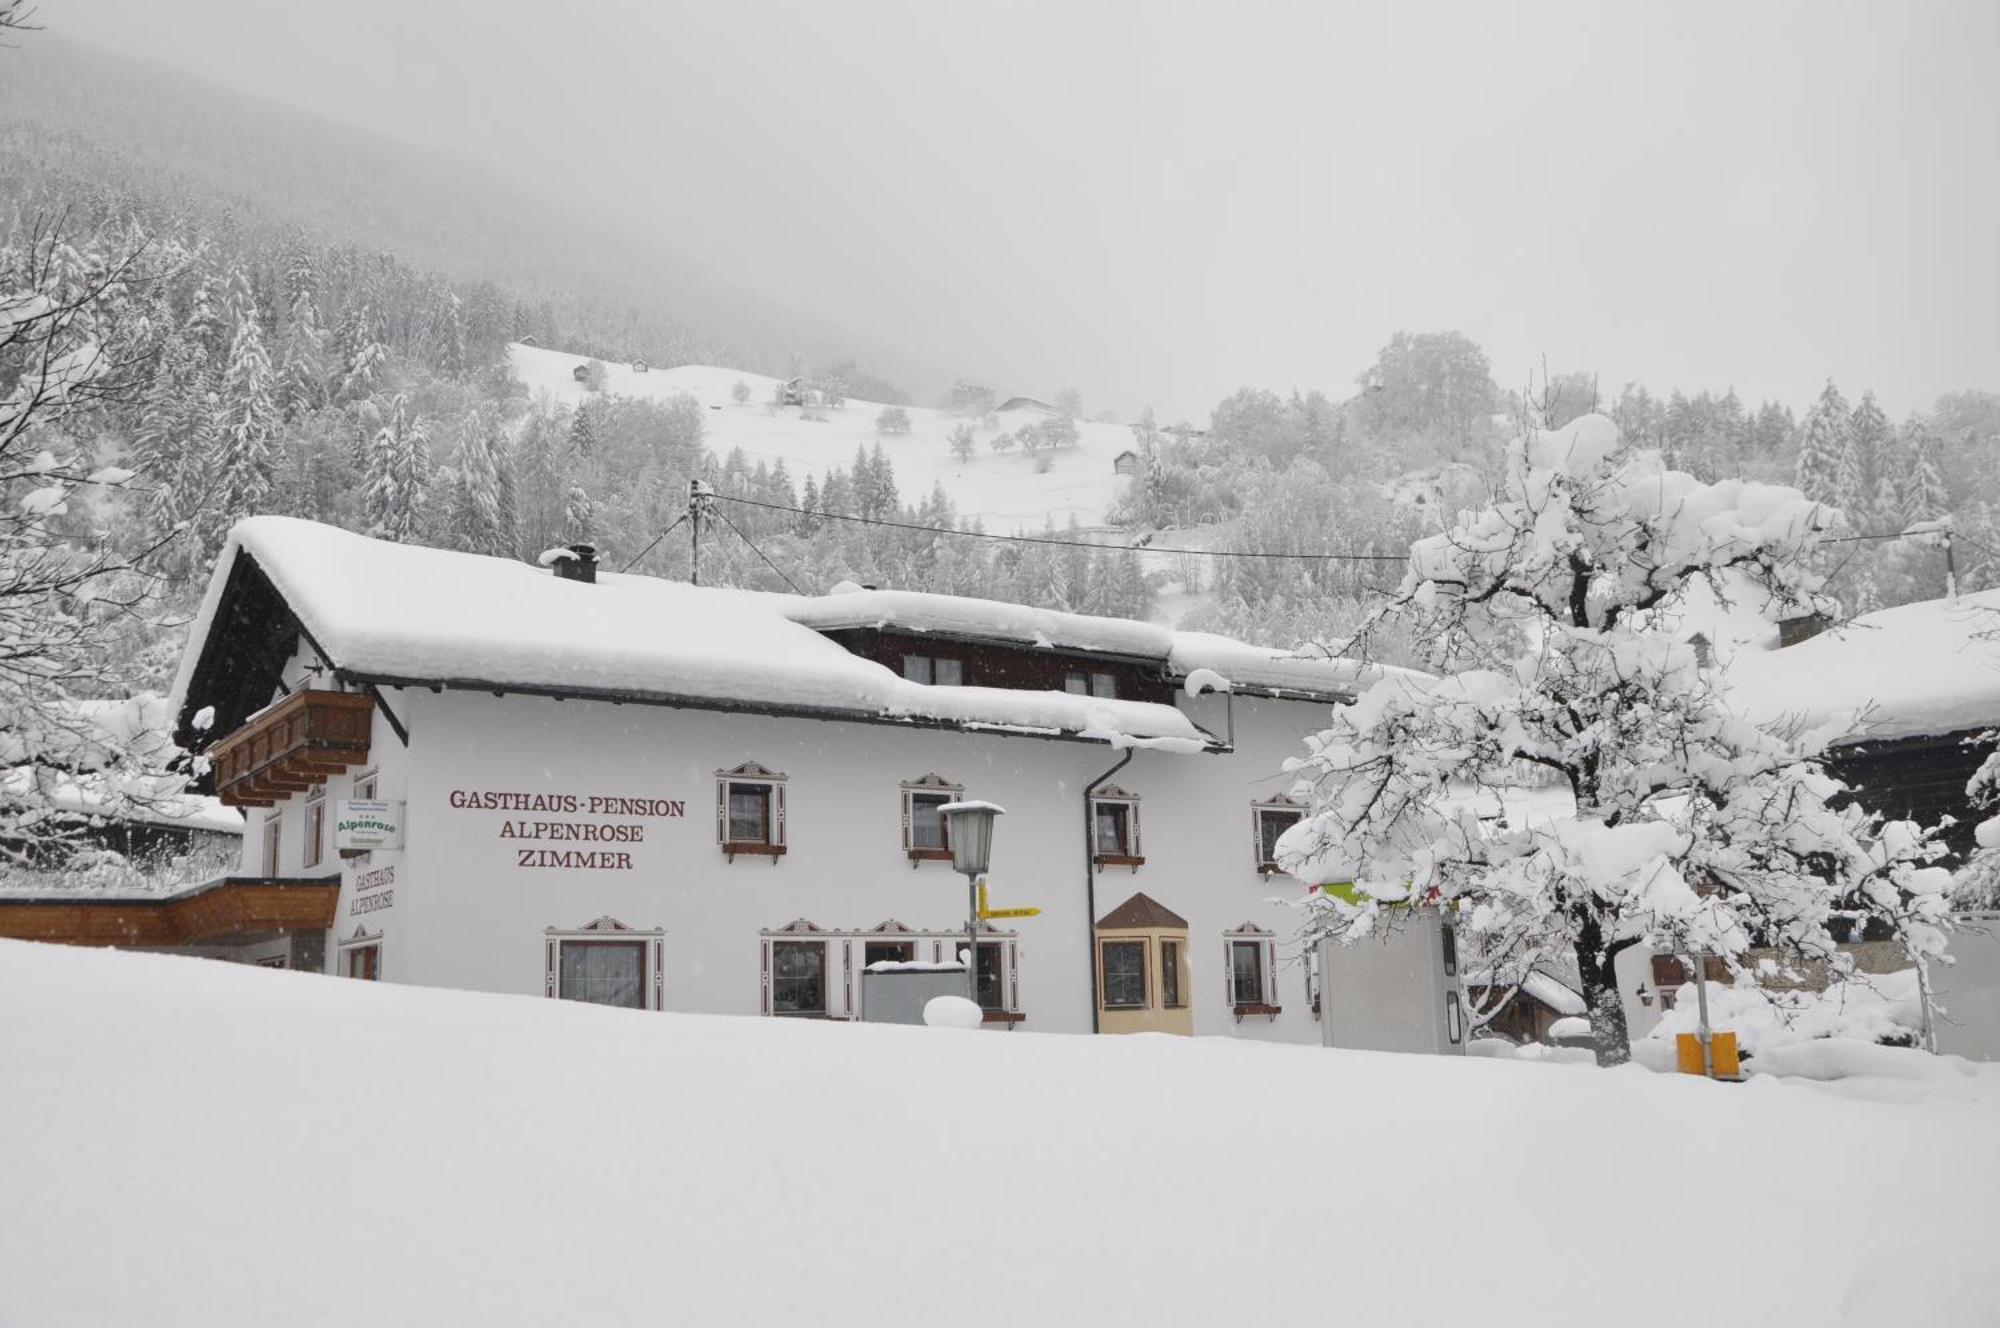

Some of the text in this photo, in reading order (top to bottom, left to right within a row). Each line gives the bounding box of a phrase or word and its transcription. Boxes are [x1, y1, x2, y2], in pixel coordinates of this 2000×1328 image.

[450, 790, 685, 818] GASTHAUS-PENSION
[338, 820, 396, 833] Alpenrose
[500, 820, 644, 843] ALPENROSE
[518, 850, 634, 870] ZIMMER
[356, 865, 394, 893] GASTHAUS
[350, 890, 393, 917] ALPENROSE
